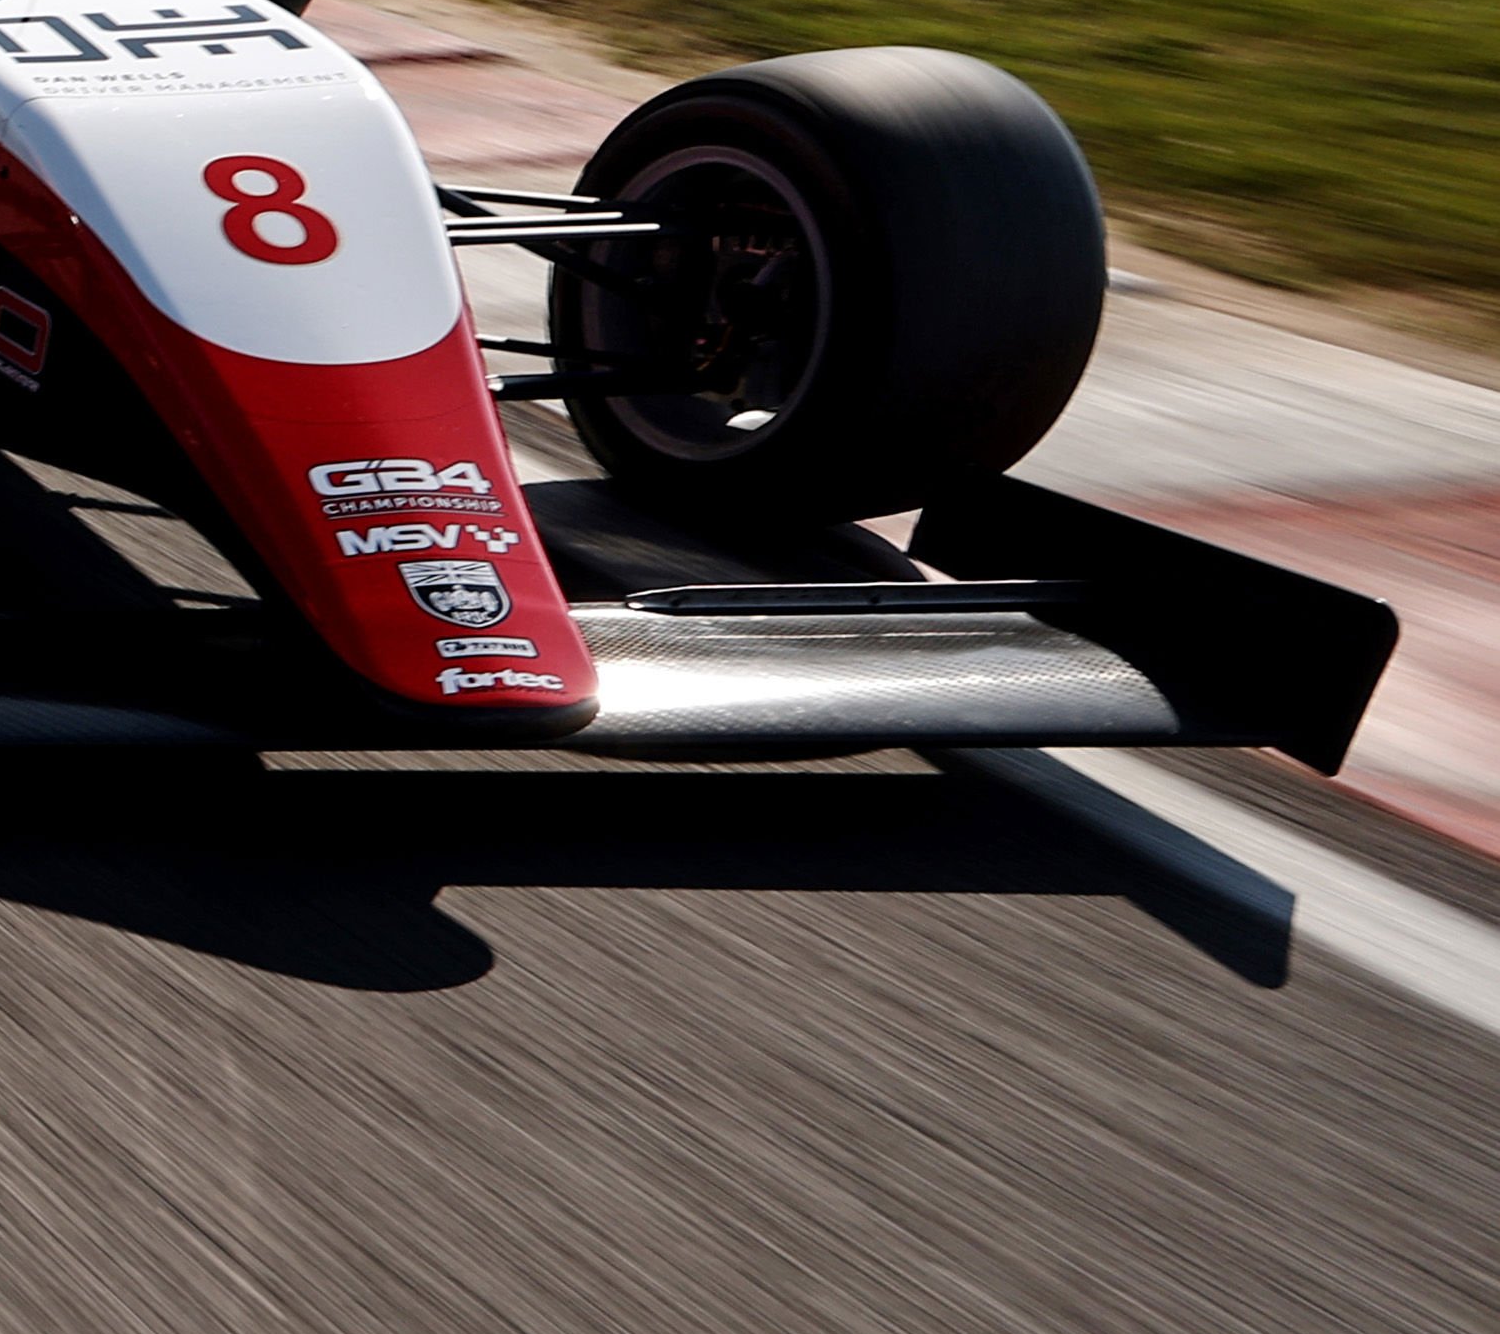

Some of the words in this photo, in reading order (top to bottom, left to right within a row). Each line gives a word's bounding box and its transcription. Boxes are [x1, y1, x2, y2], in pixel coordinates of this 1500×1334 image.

[32, 74, 87, 84] DAN
[95, 70, 185, 83] WELLS
[42, 83, 149, 96] DRIVER
[153, 71, 350, 94] MANAGEMENT
[202, 154, 339, 266] 8
[308, 458, 492, 497] GB4
[322, 496, 503, 516] CHAMPIONSHIP
[336, 523, 461, 557] MSV
[435, 667, 564, 696] fortec
